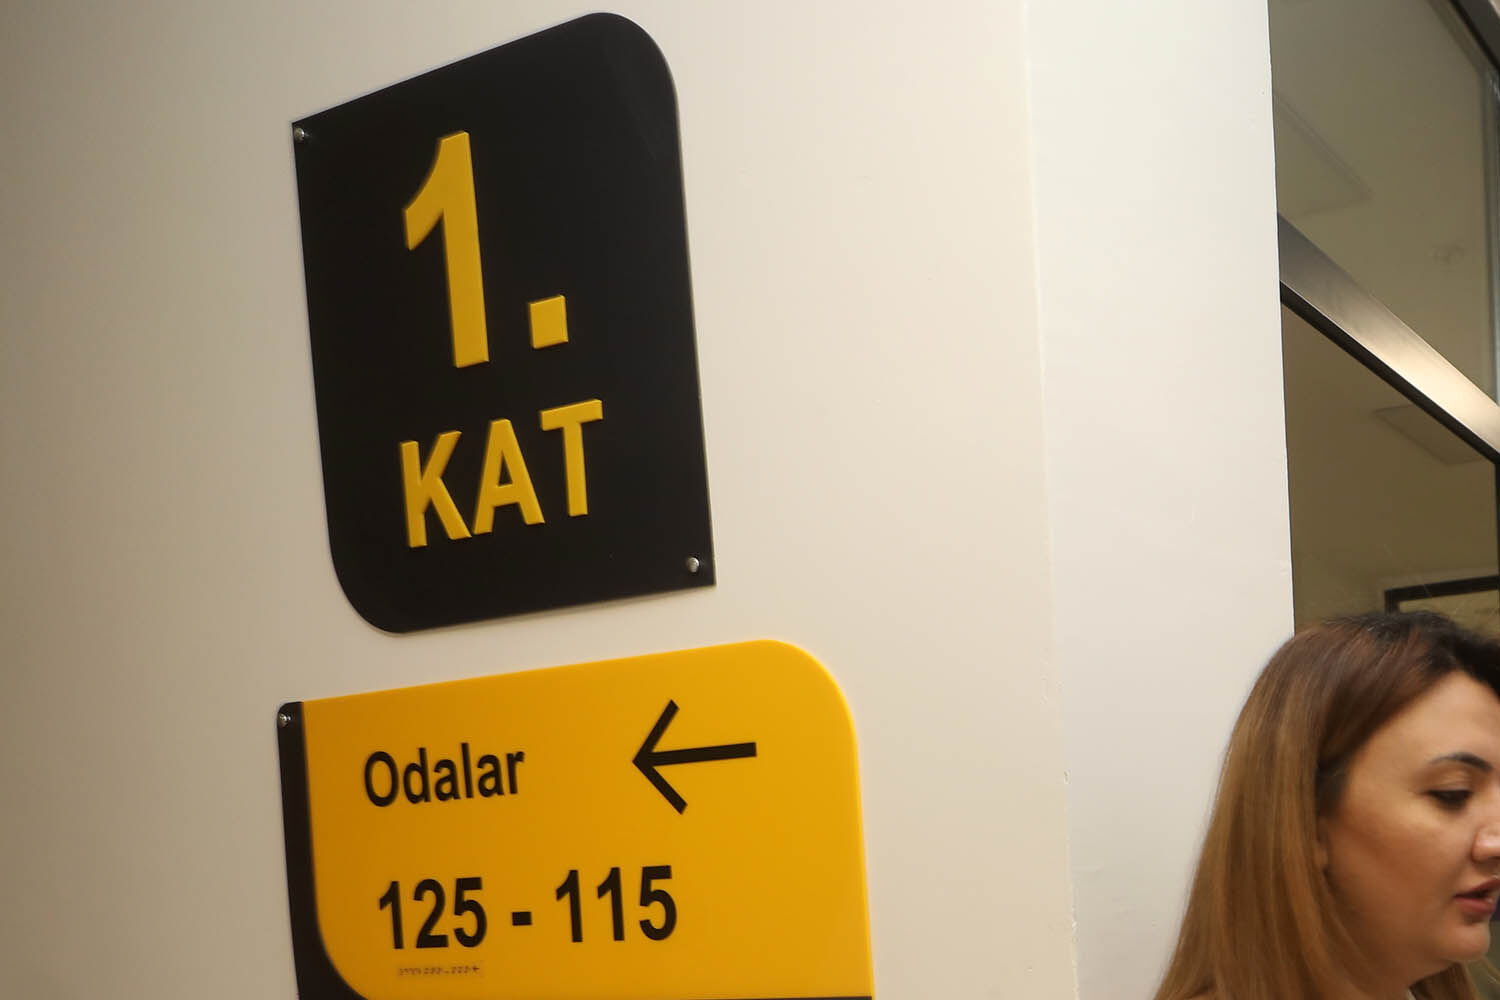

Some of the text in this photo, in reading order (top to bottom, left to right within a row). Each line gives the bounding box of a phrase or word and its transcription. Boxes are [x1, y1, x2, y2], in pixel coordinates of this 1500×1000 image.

[403, 131, 569, 368] 1.
[400, 399, 604, 547] KAT
[364, 742, 525, 807] Odalar
[378, 865, 677, 949] 125 - 115
